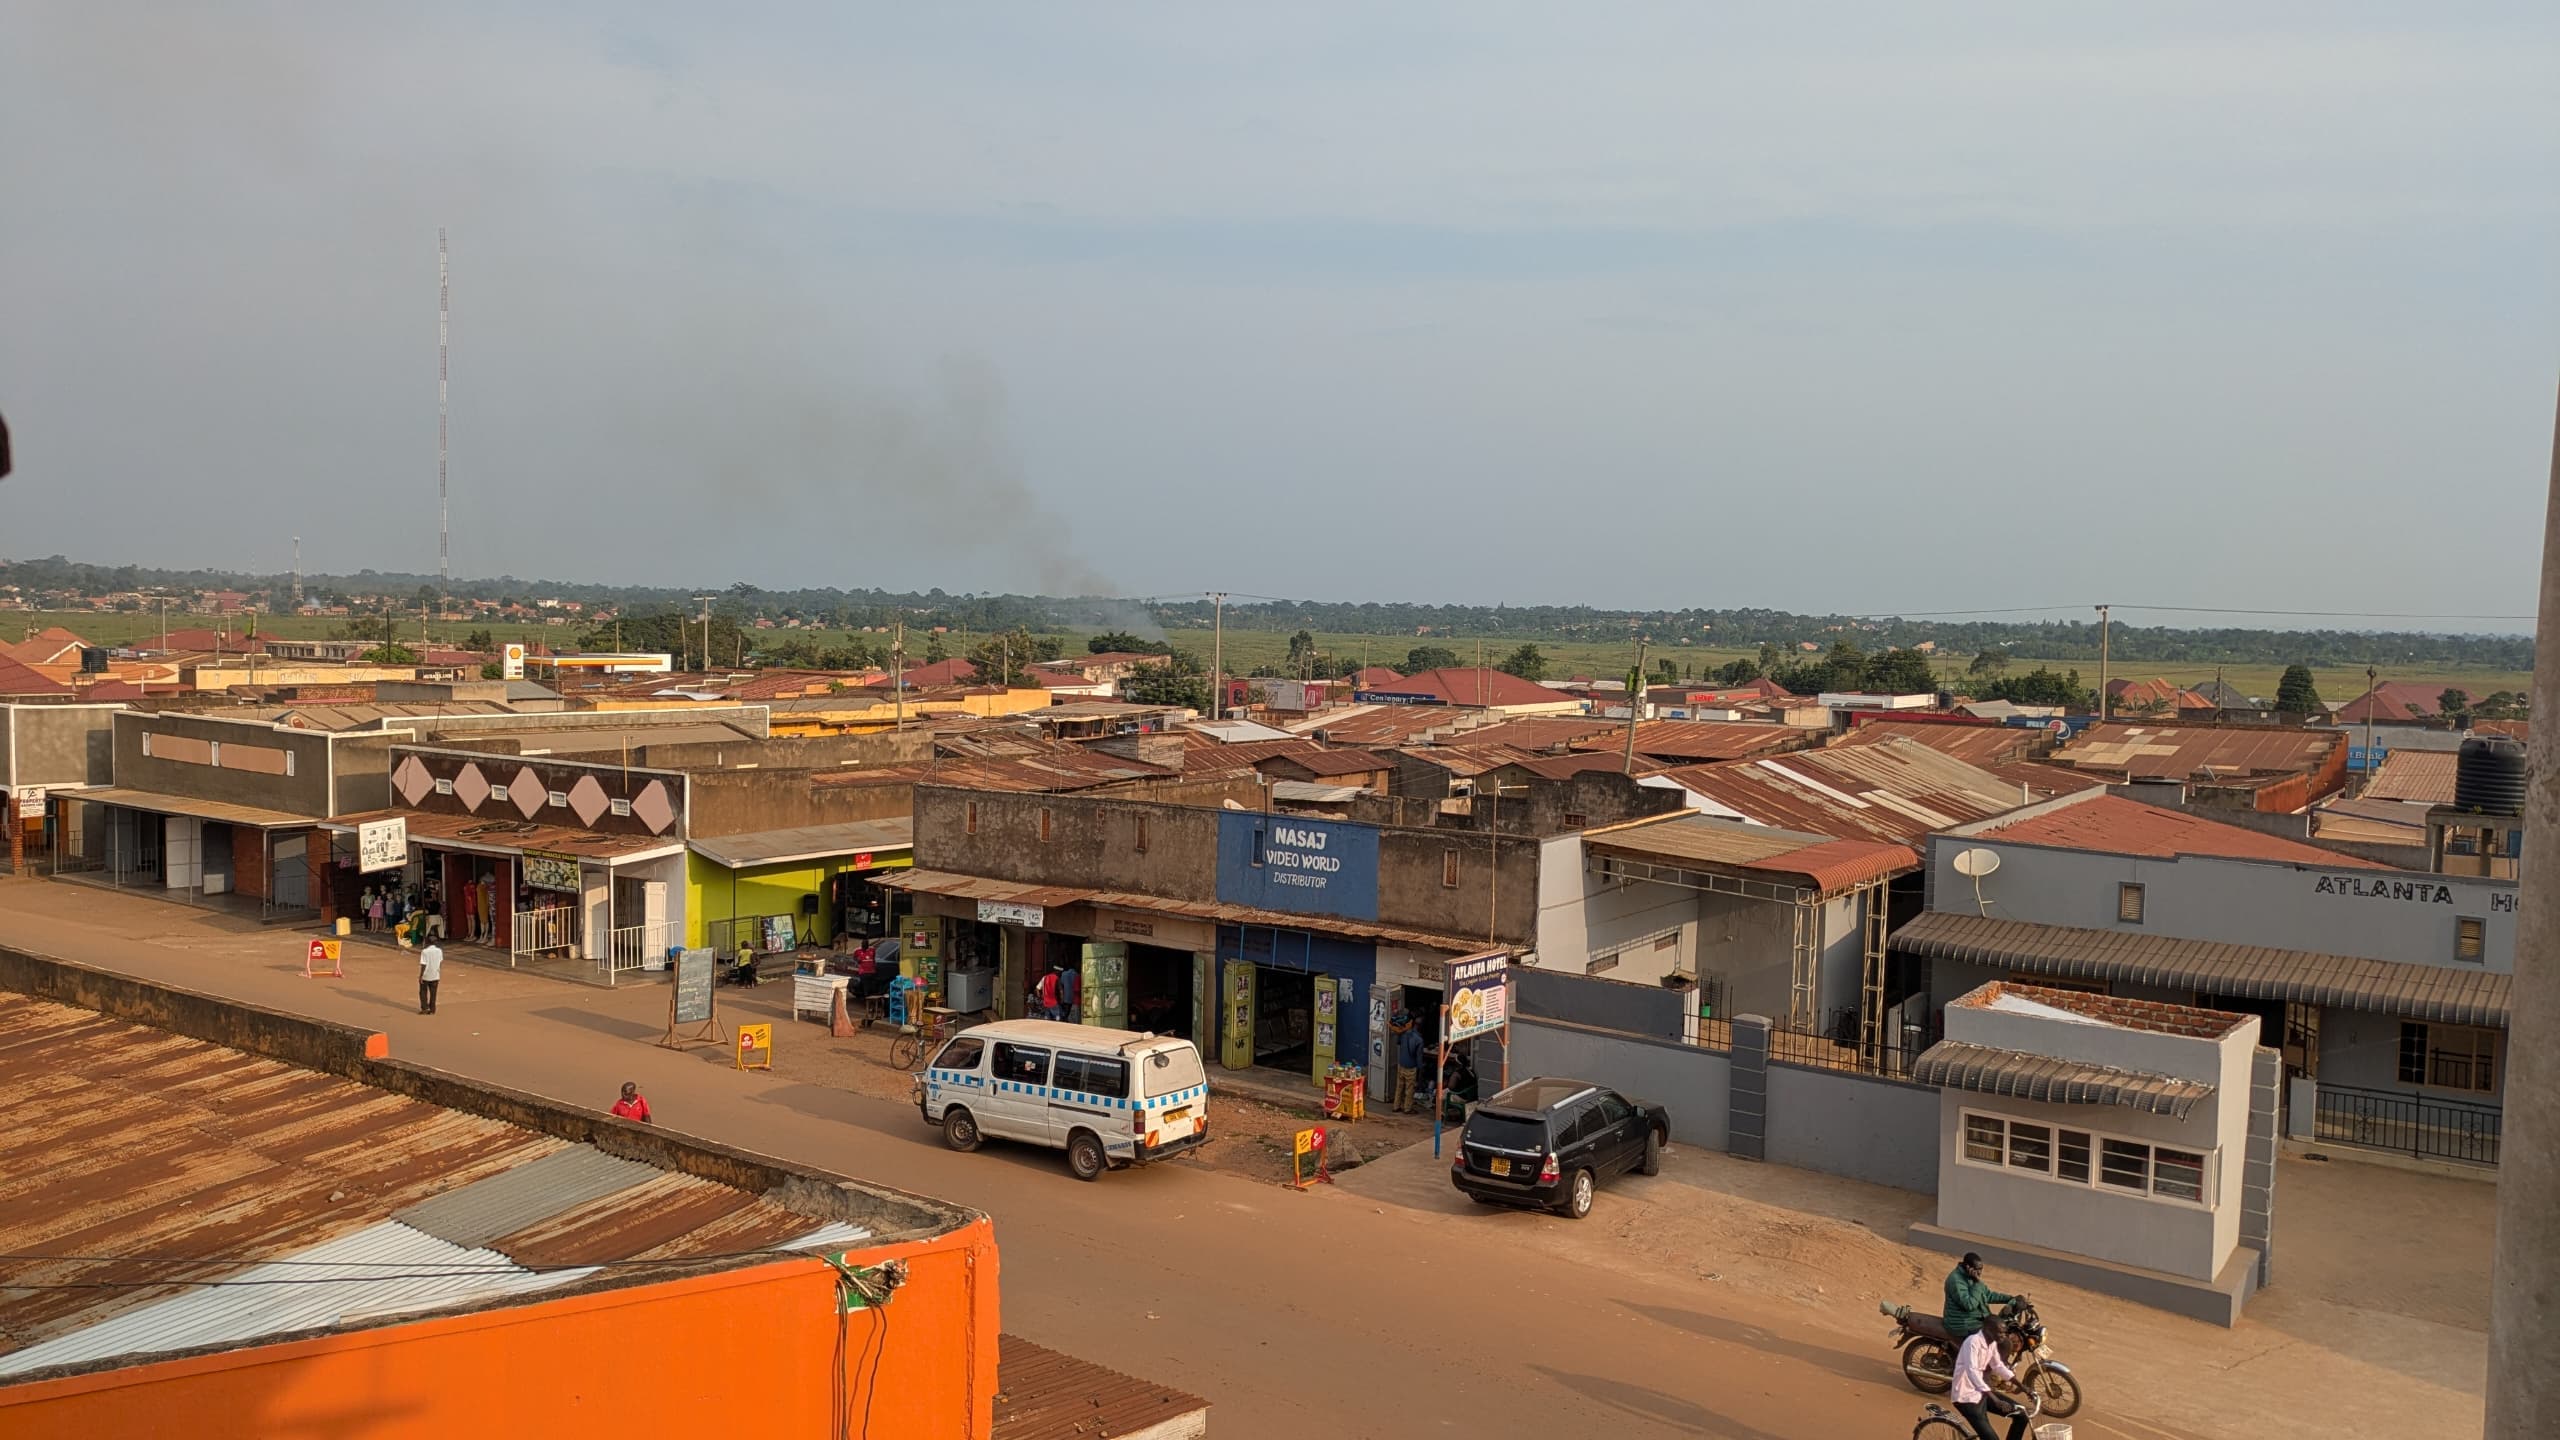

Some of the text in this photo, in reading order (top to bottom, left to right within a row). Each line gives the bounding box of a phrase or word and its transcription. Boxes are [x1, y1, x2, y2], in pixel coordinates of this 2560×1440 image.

[1275, 827, 1327, 850] NASAJ
[1266, 849, 1340, 872] VIDEO WORLD
[1273, 871, 1327, 888] DISTRIBUTOR
[2315, 876, 2454, 904] ATLANTA
[1454, 956, 1508, 980] ATLANTA HOTEL
